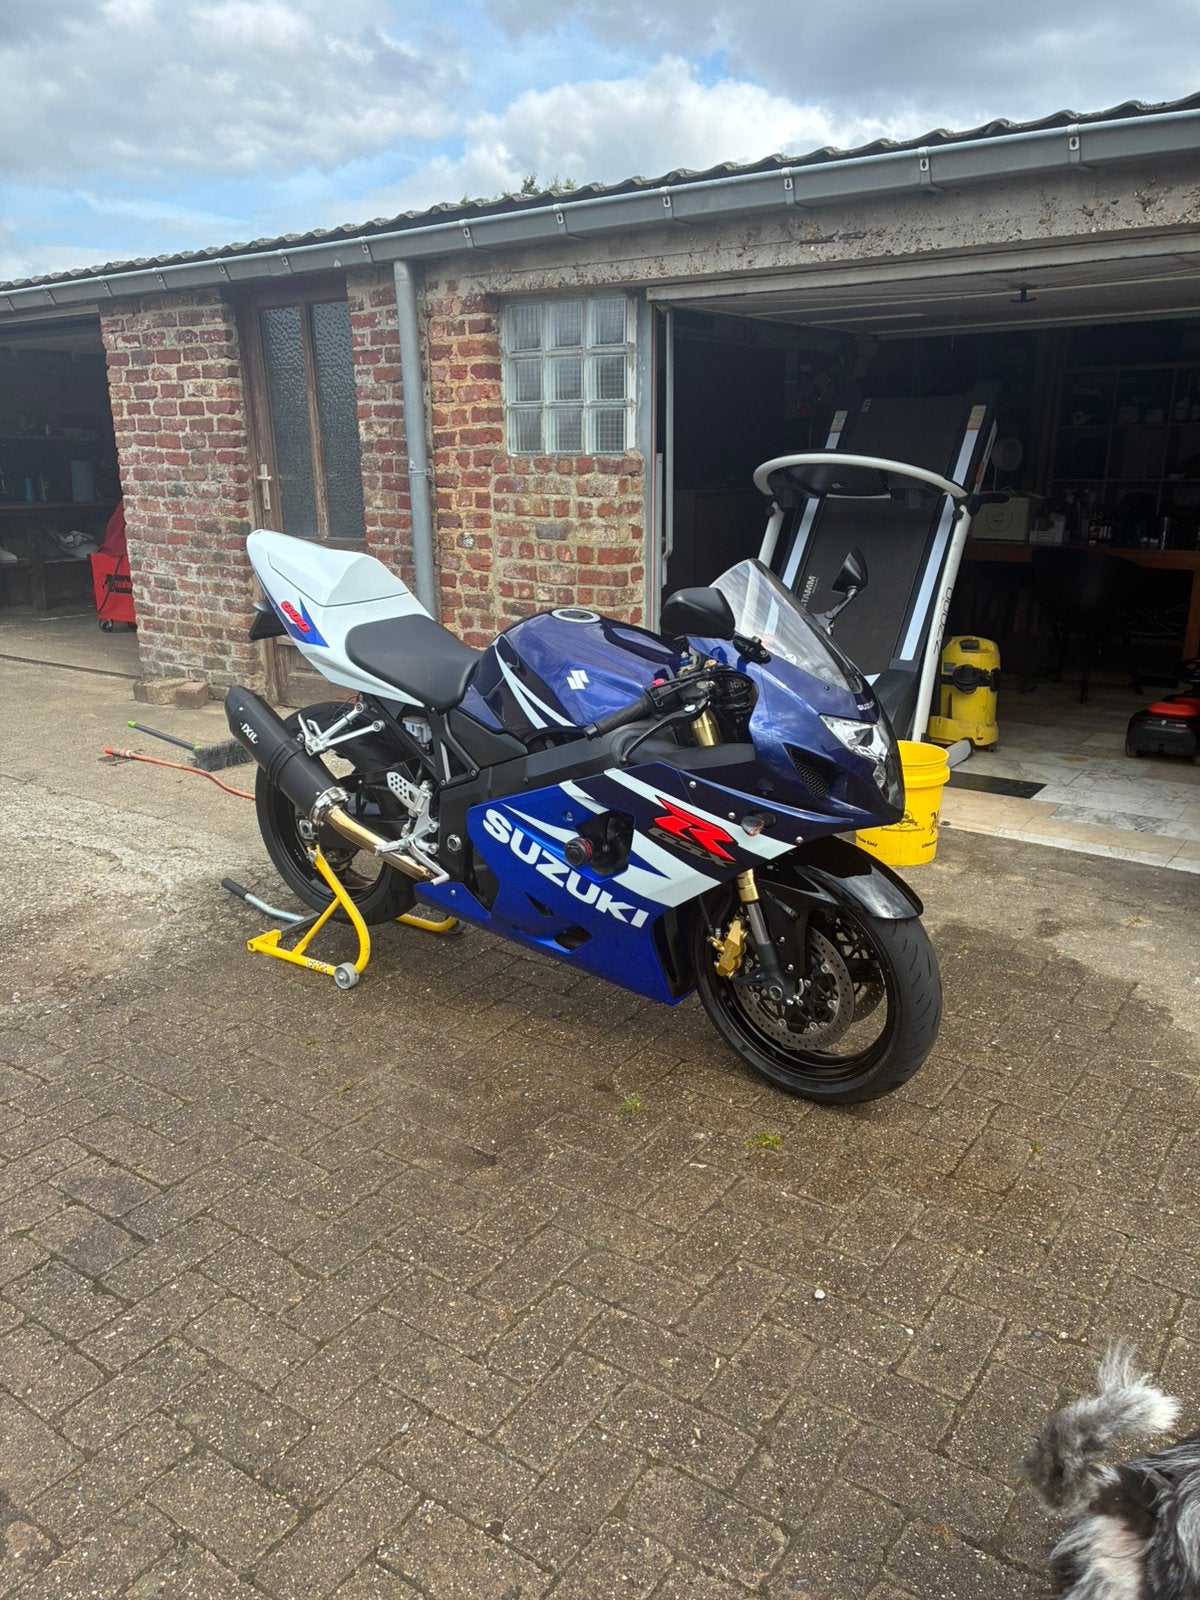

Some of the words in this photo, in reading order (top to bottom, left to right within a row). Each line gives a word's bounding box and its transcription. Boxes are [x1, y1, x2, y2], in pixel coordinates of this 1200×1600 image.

[280, 600, 311, 633] 600
[857, 699, 875, 711] SUZU
[482, 808, 649, 929] SUZUKI
